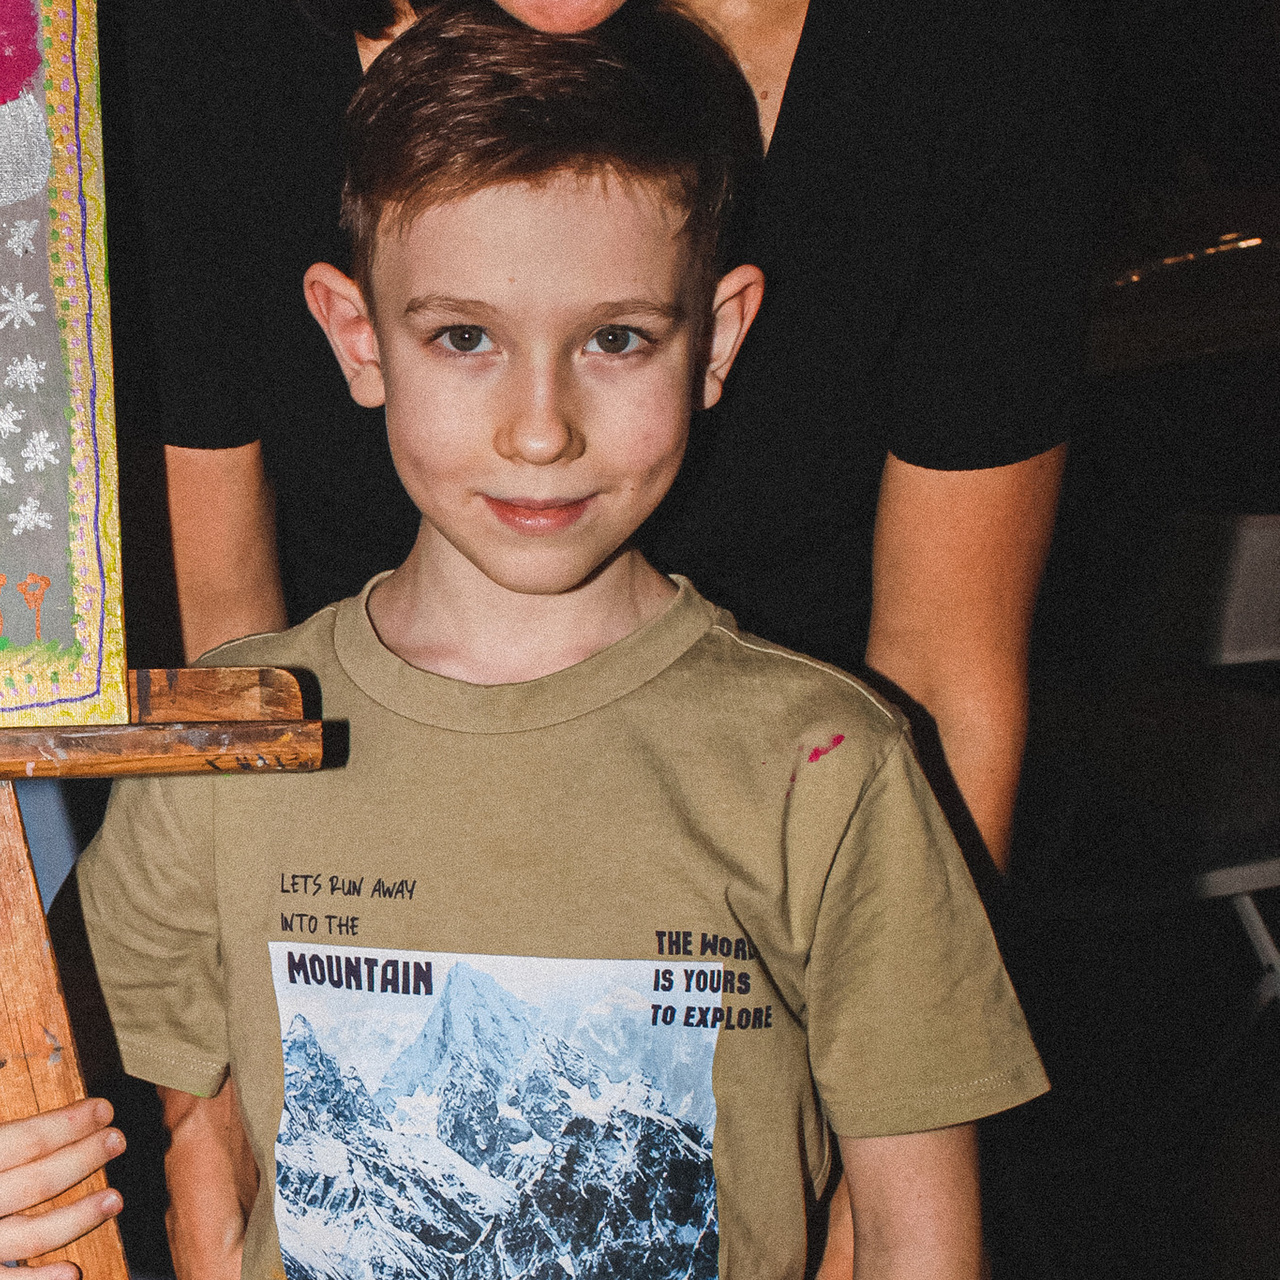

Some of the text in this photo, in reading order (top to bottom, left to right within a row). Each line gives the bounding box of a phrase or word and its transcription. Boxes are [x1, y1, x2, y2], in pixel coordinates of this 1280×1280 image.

[280, 873, 417, 900] LETS RUN AWAY
[280, 912, 360, 936] INTO THE
[655, 930, 693, 956] THE
[287, 951, 434, 996] MOUNTAIN
[653, 968, 752, 995] IS YOURS
[651, 1003, 773, 1030] TO EXPLORE
